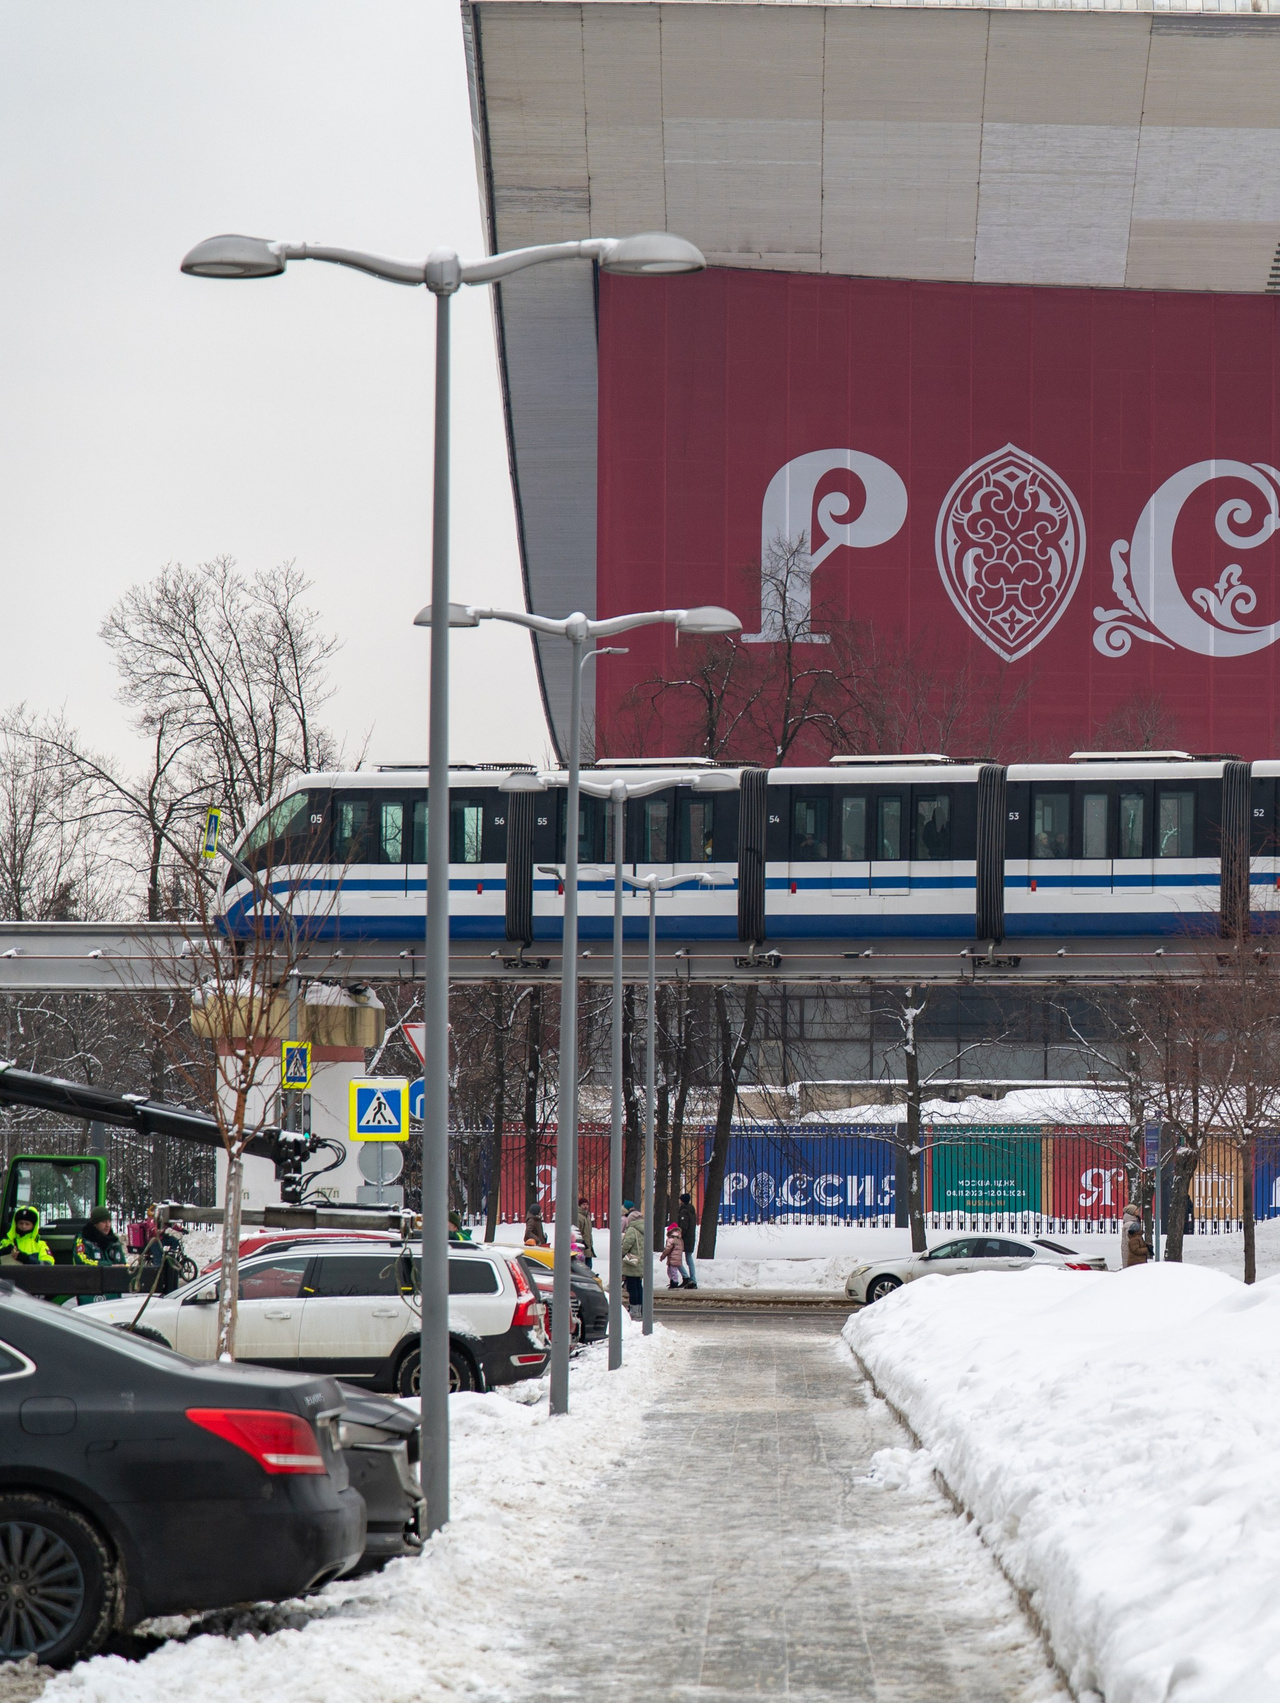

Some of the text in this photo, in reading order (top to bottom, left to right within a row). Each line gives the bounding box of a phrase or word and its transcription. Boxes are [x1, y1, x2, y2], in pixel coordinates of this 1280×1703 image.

[1008, 812, 1019, 820] 53
[1253, 809, 1264, 817] 52
[310, 814, 322, 824] 05
[494, 817, 505, 825] 56
[537, 817, 548, 826] 55
[769, 815, 780, 823] 54
[1195, 1197, 1235, 1208] ВДНХ
